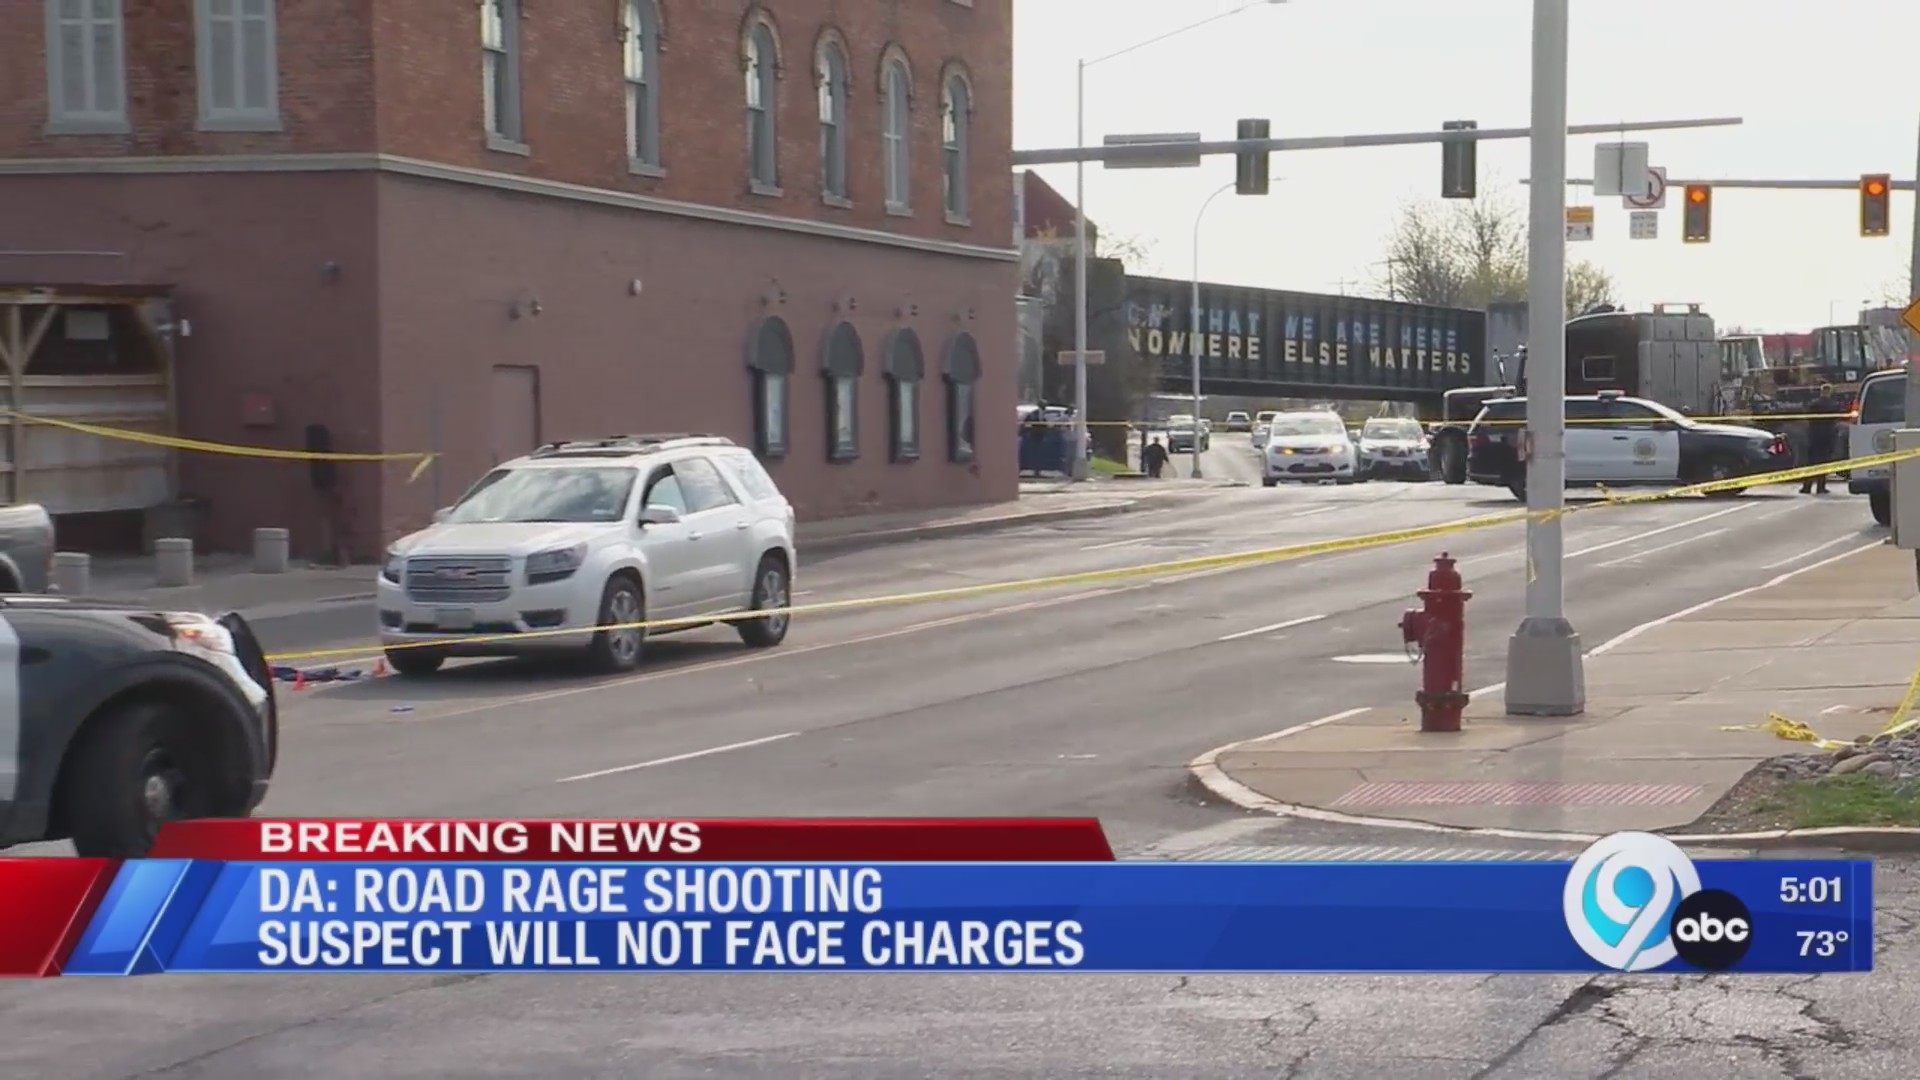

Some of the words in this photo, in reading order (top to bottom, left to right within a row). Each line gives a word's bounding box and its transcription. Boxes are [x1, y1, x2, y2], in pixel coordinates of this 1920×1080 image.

[1127, 328, 1260, 360] NOWHERE
[1284, 339, 1348, 366] ELSE
[1368, 347, 1471, 374] MATTERS
[1190, 307, 1260, 336] THAT
[1284, 315, 1313, 340] WE
[1336, 321, 1380, 345] ARE
[1401, 326, 1457, 351] HERE
